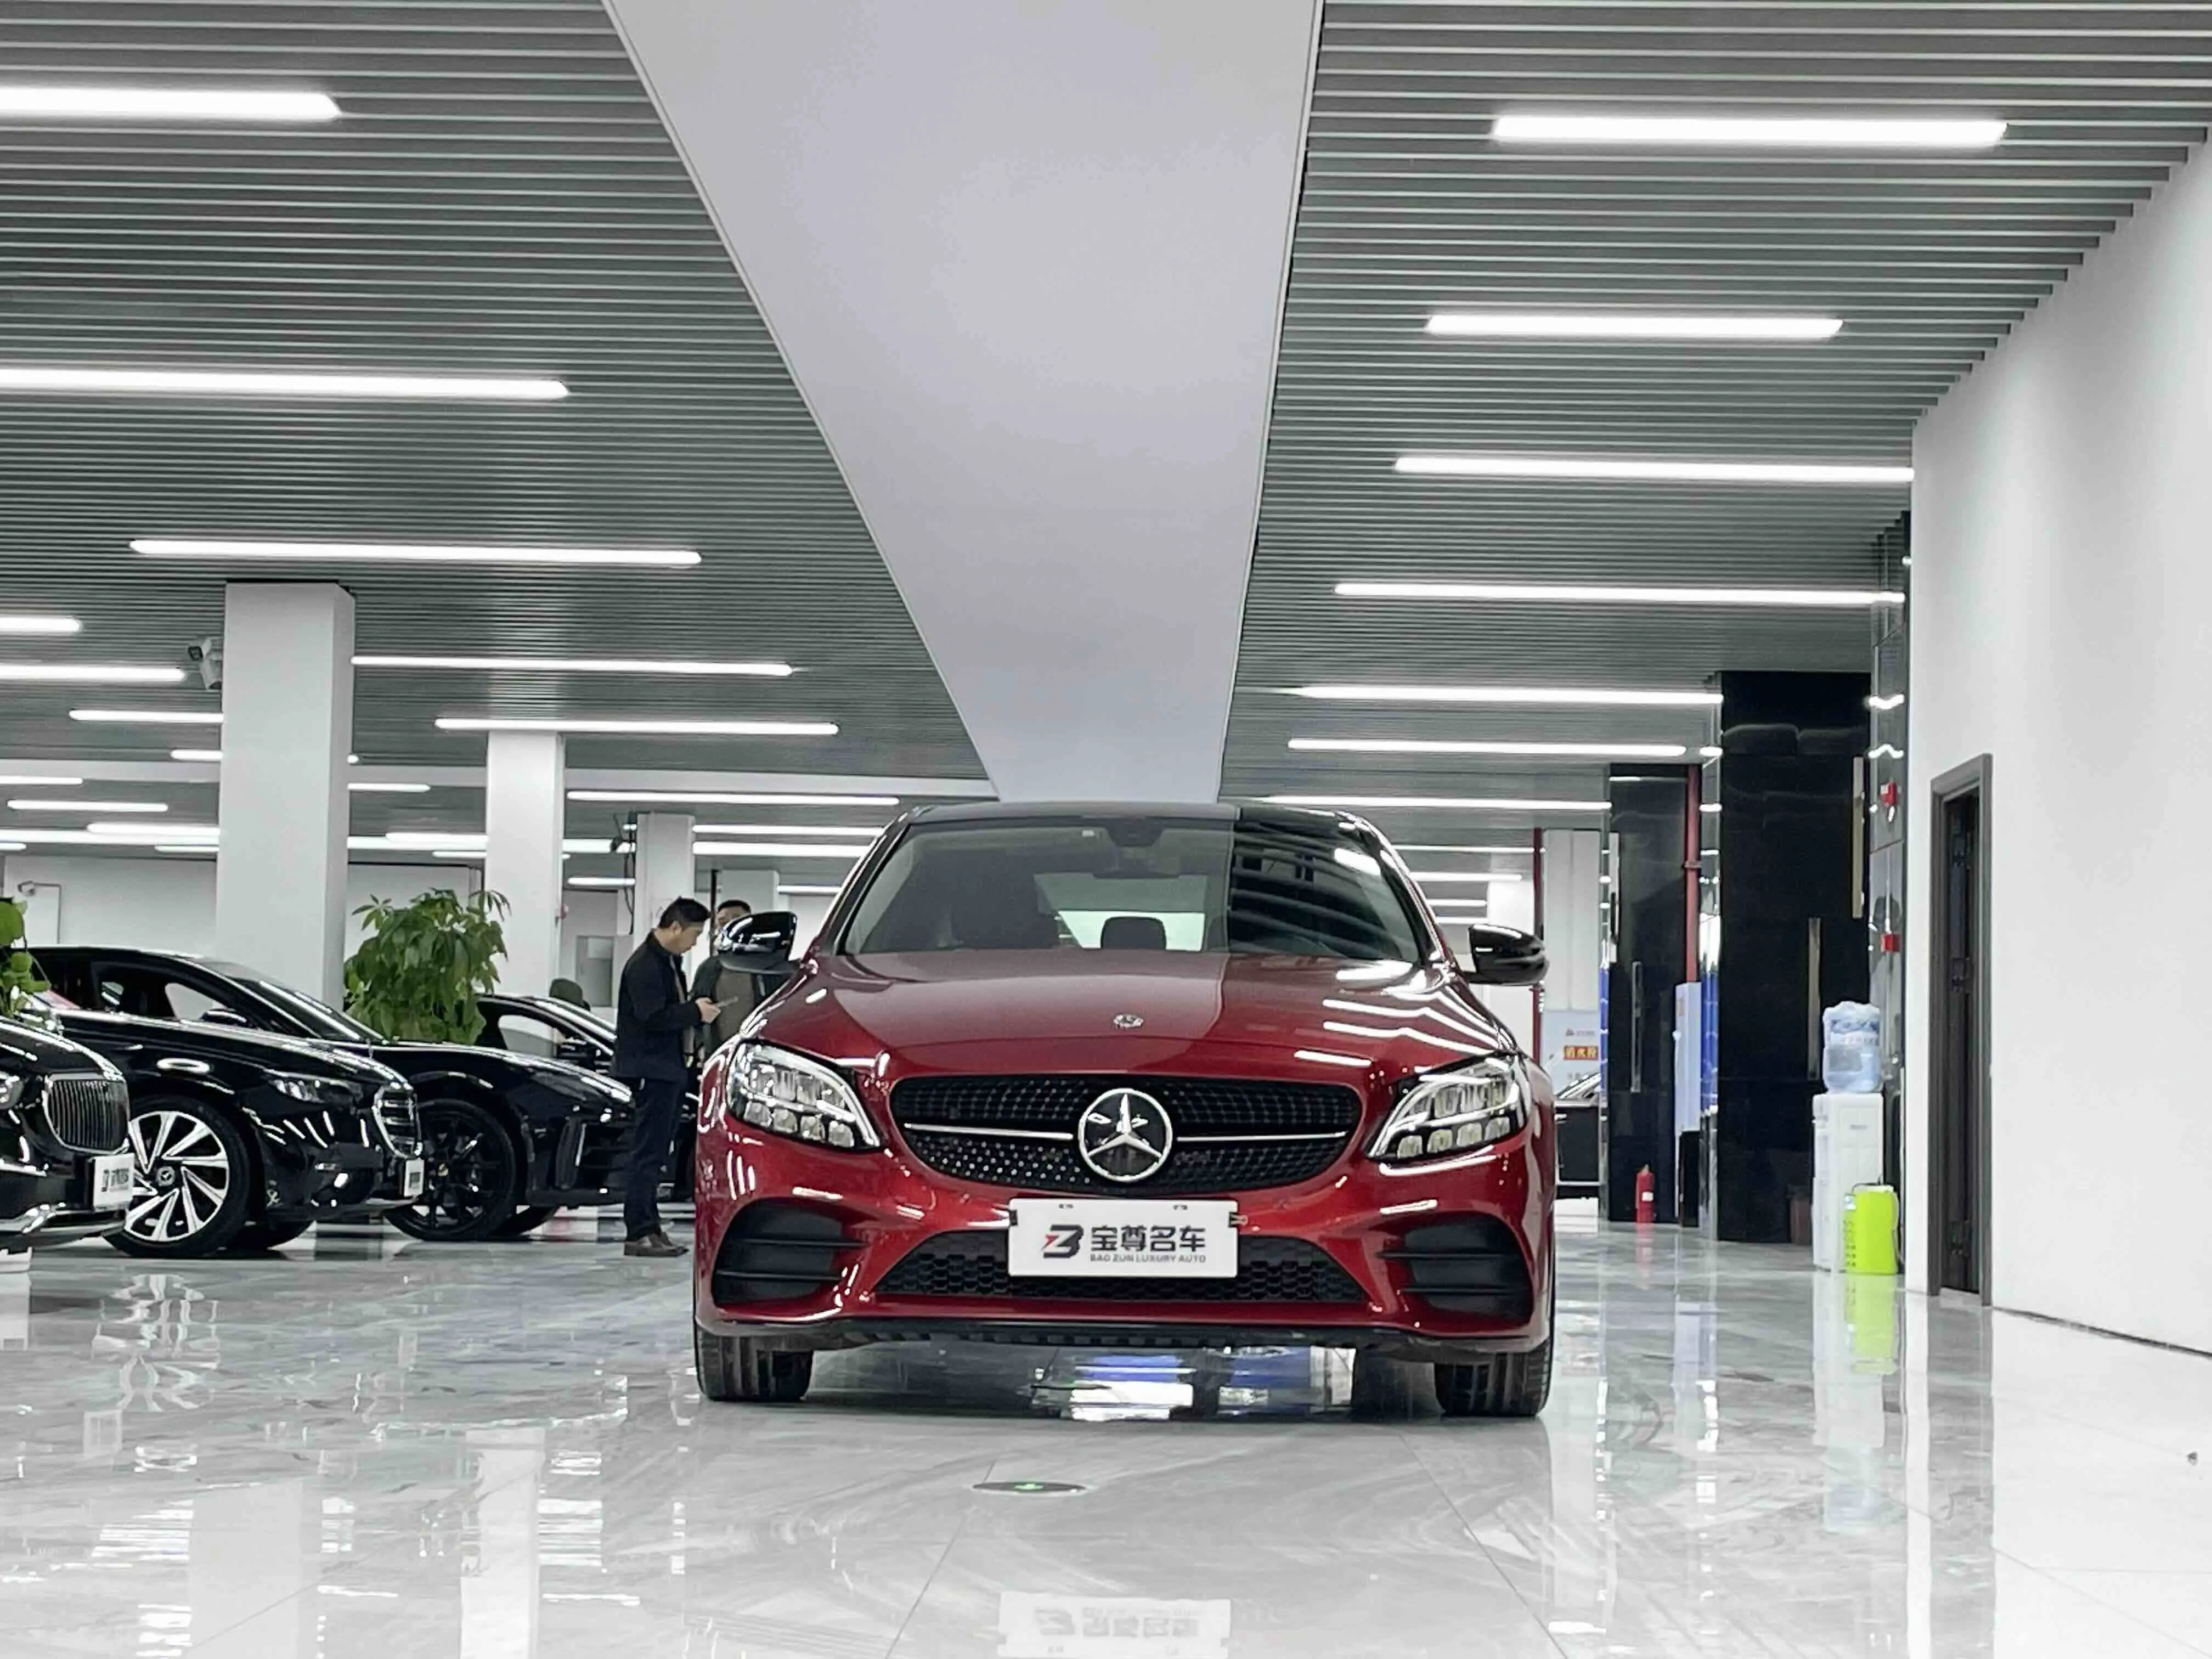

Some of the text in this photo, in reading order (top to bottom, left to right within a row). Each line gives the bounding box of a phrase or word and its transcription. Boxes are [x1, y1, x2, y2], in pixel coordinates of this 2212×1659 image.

[1091, 1224, 1206, 1252] 宝尊名车
[1090, 1254, 1206, 1263] BAO ZUN LUXURY AUTO
